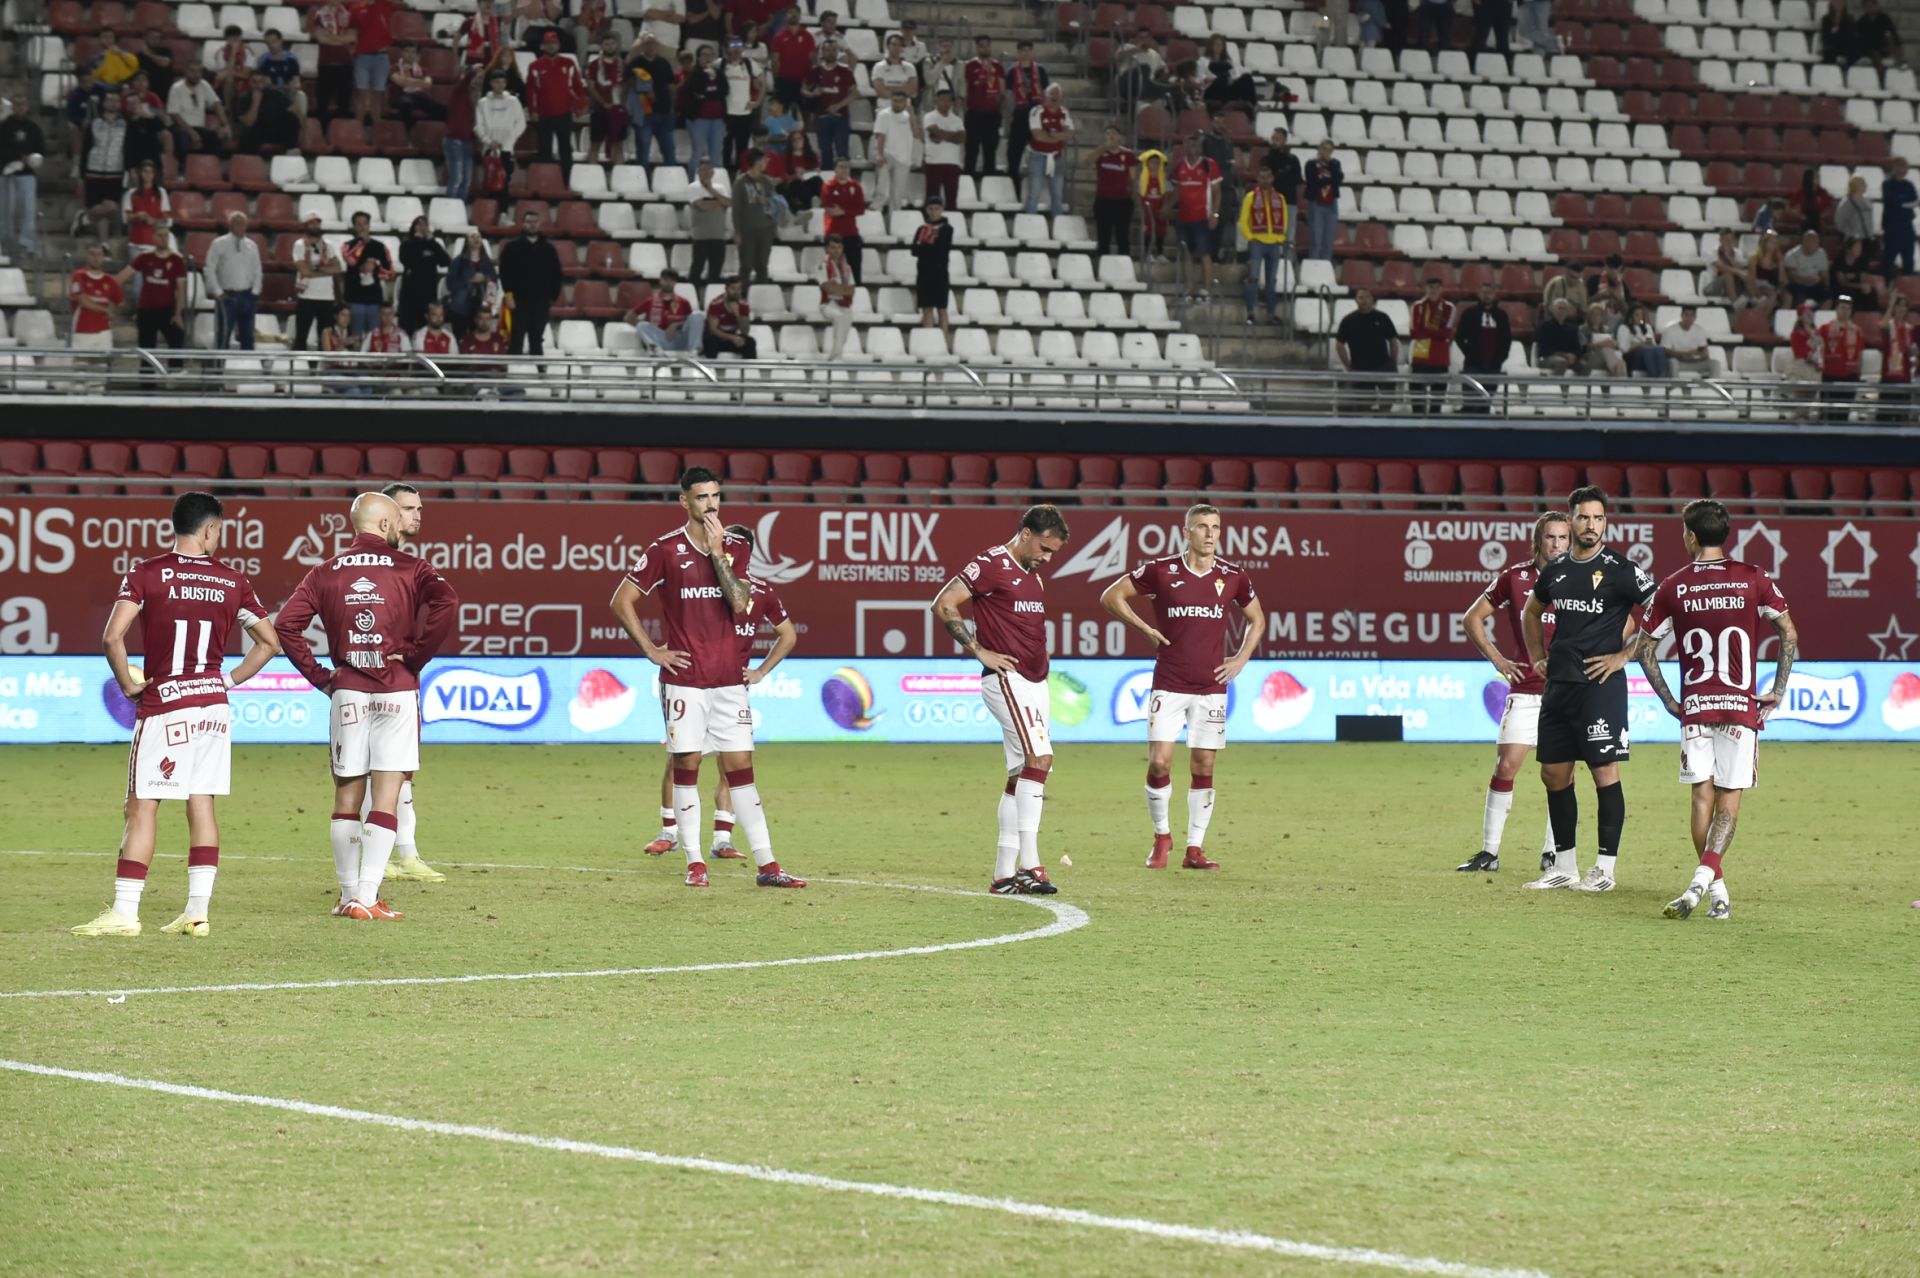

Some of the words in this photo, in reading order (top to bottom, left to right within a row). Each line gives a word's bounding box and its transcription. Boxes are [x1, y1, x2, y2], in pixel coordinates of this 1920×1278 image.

[82, 506, 264, 549] correría
[819, 511, 939, 562] FENIX
[1138, 524, 1294, 556] OMNSA
[1300, 540, 1330, 557] S.L.
[332, 553, 395, 570] joma
[501, 532, 545, 570] de
[552, 534, 644, 572] Jesús
[176, 572, 236, 588] aparcamurcia
[818, 564, 910, 581] INVESTMENTS
[914, 566, 945, 582] 1992
[168, 586, 180, 599] A.
[181, 586, 226, 603] BUSTOS
[680, 586, 723, 599] INVERS
[1689, 581, 1749, 592] aparcamurcia
[1167, 603, 1224, 620] INVERSUS
[1684, 596, 1745, 612] PALMBERG
[459, 604, 524, 632] pre
[348, 630, 383, 644] lesco
[459, 636, 548, 655] zero
[168, 619, 213, 677] 11
[1683, 626, 1752, 690] 30
[24, 670, 82, 698] Más
[1329, 675, 1357, 698] La
[1361, 674, 1411, 698] Vida
[1417, 674, 1466, 699] Más
[436, 685, 532, 711] VIDAL
[1025, 706, 1045, 727] 14
